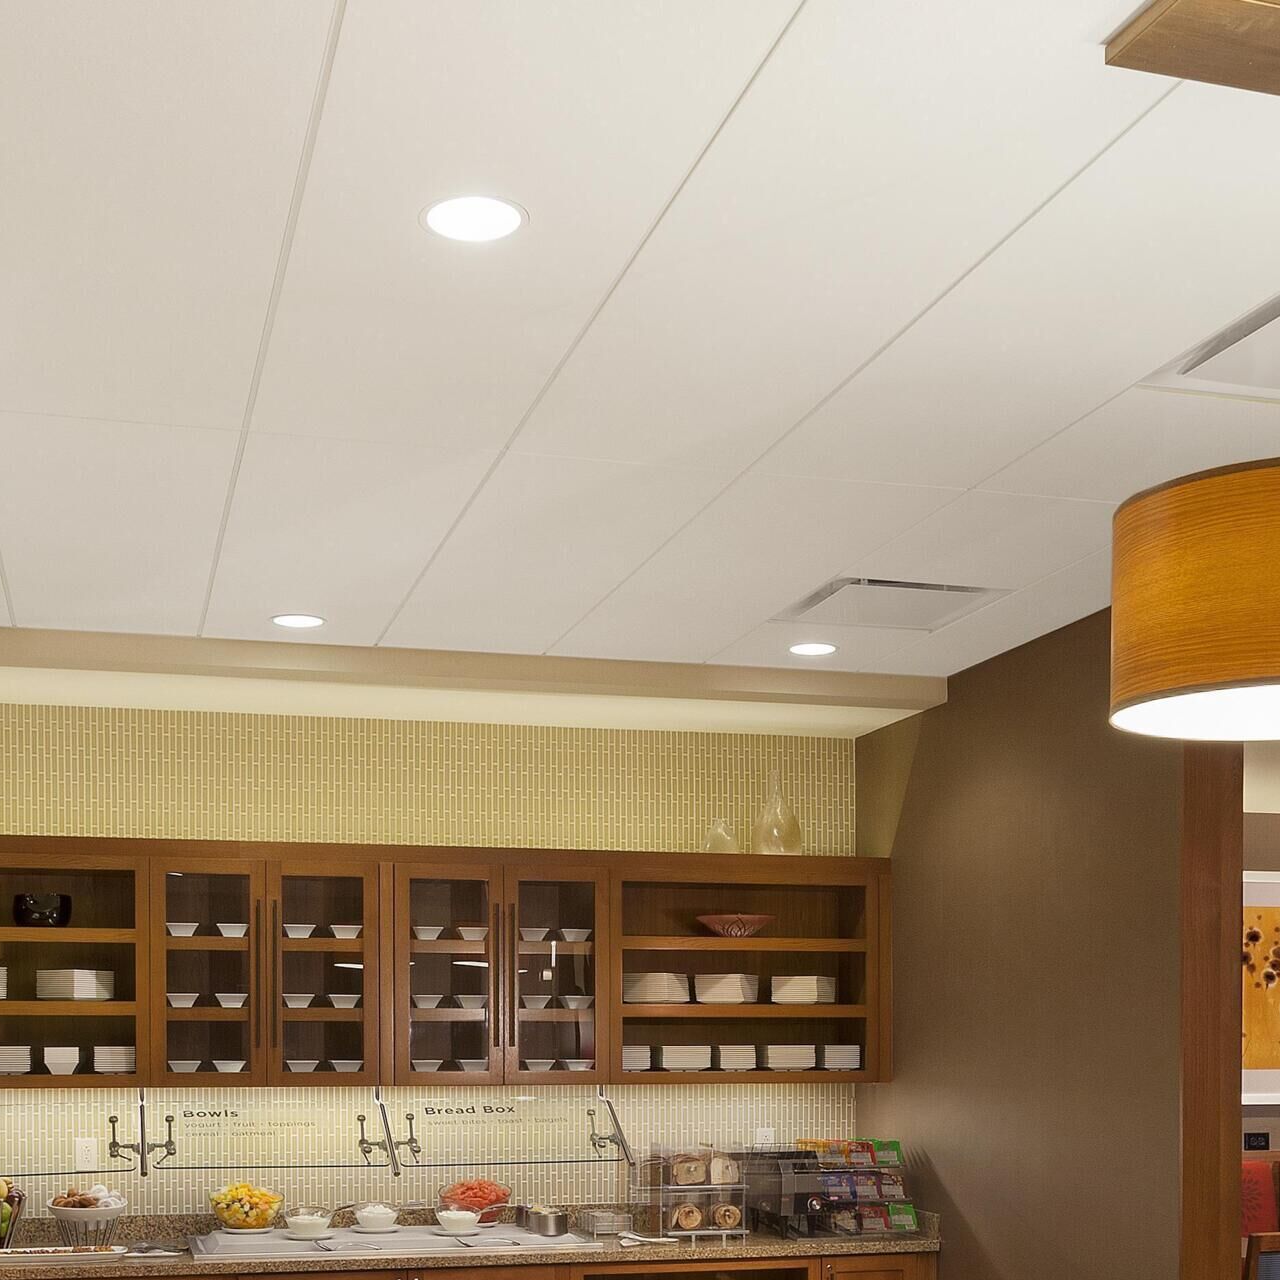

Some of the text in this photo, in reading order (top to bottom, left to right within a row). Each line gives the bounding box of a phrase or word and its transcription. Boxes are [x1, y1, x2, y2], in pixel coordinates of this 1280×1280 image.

[183, 1109, 239, 1118] Bowls
[424, 1105, 516, 1115] Bread Box
[184, 1121, 222, 1129] yogurt
[267, 1120, 317, 1128] toppings
